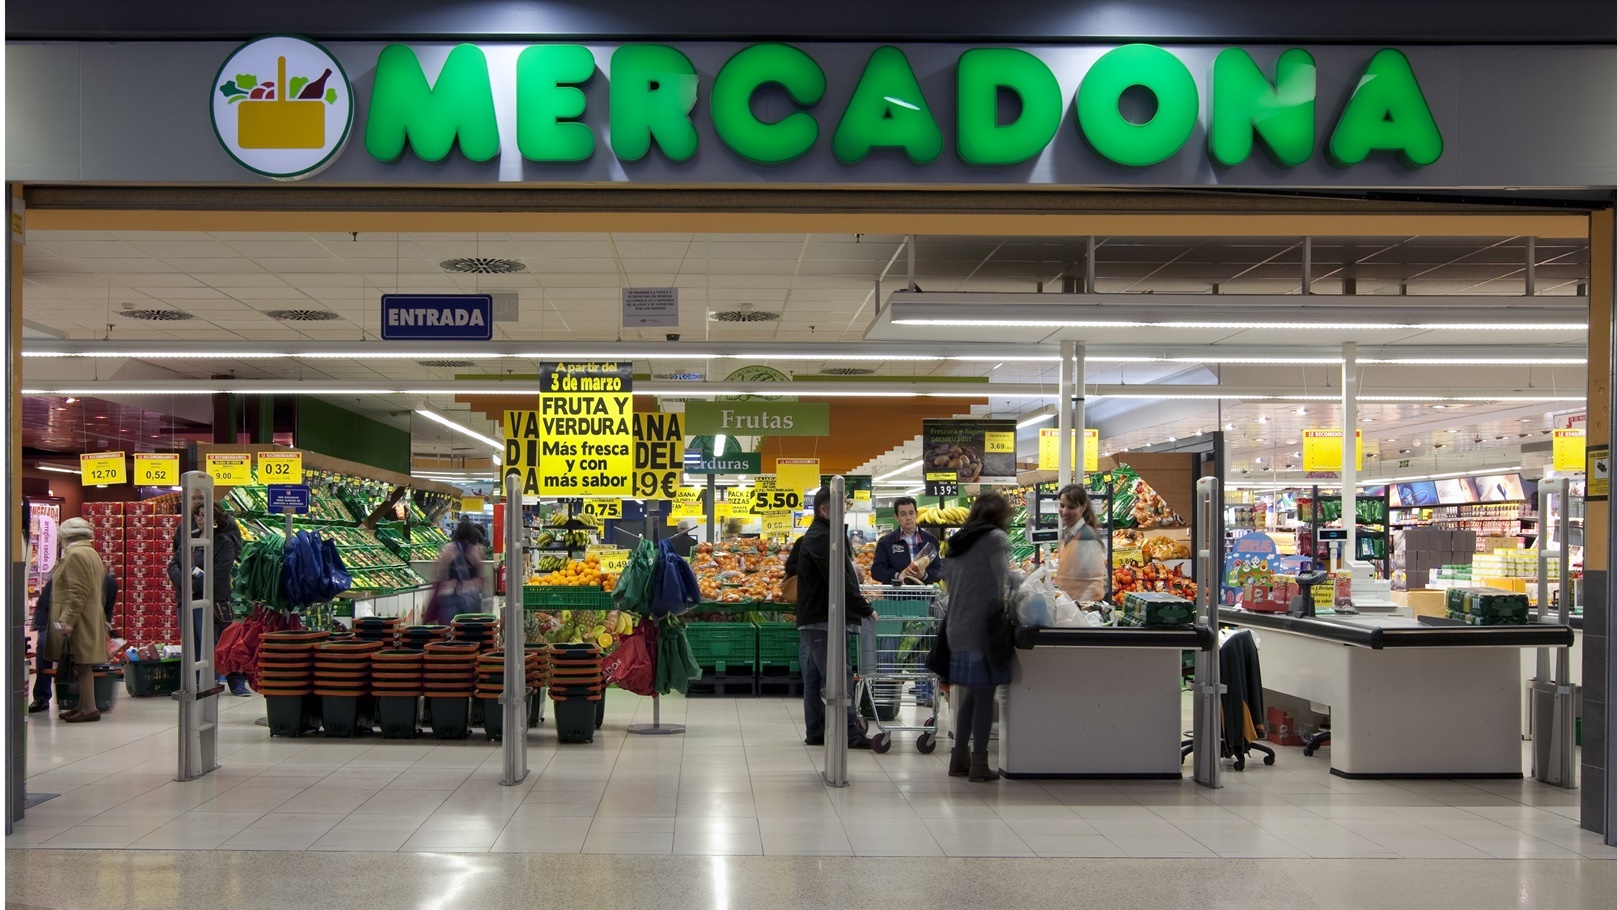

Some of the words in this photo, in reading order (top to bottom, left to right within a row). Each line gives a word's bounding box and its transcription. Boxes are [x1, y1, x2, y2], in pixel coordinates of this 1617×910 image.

[365, 43, 1444, 165] MERCADONA
[388, 308, 485, 326] ENTRADA
[555, 362, 564, 372] A
[568, 363, 600, 374] partir
[603, 362, 618, 372] del
[551, 374, 559, 391] 3
[562, 374, 579, 390] de
[580, 376, 622, 391] marzo
[542, 396, 609, 415] FRUTA
[613, 396, 630, 415] Y
[543, 418, 630, 436] VERDURA
[720, 410, 794, 430] Frutas
[542, 441, 577, 456] Más
[580, 442, 630, 456] fresca
[635, 442, 683, 470] DEL
[265, 464, 290, 475] 0,32
[566, 460, 575, 472] y
[579, 458, 608, 470] con
[91, 470, 117, 480] 12,70
[146, 471, 166, 480] 0,52
[544, 472, 578, 487] más
[584, 472, 628, 487] sabor
